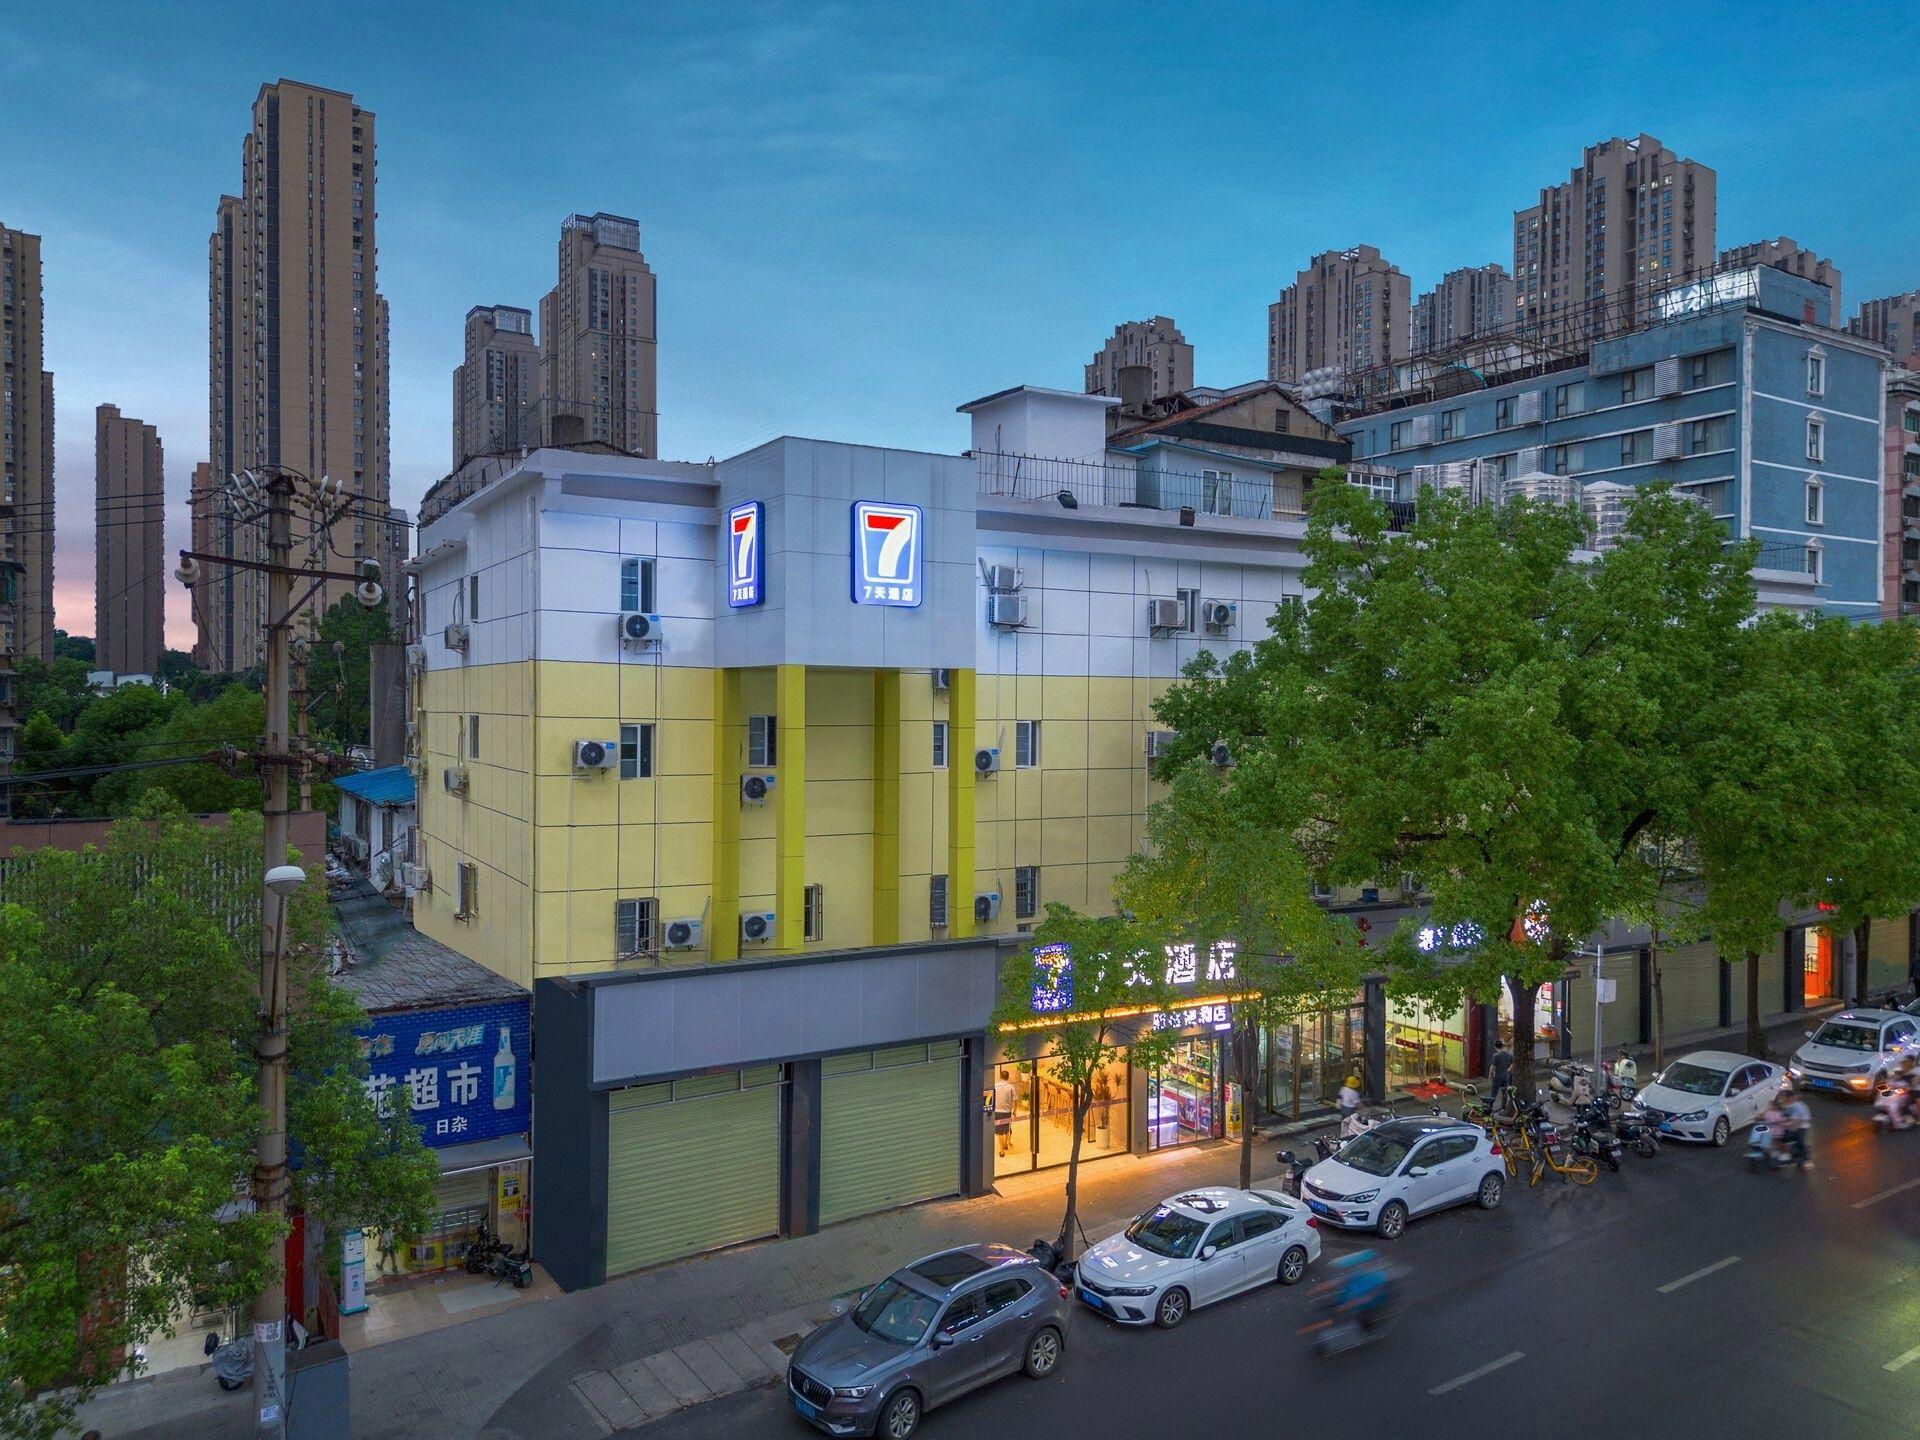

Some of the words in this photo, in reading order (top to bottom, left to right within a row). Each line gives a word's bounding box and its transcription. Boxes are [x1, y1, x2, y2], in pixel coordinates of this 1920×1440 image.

[733, 513, 755, 578] 7
[865, 513, 912, 577] 7
[435, 1115, 469, 1135] 日杂
